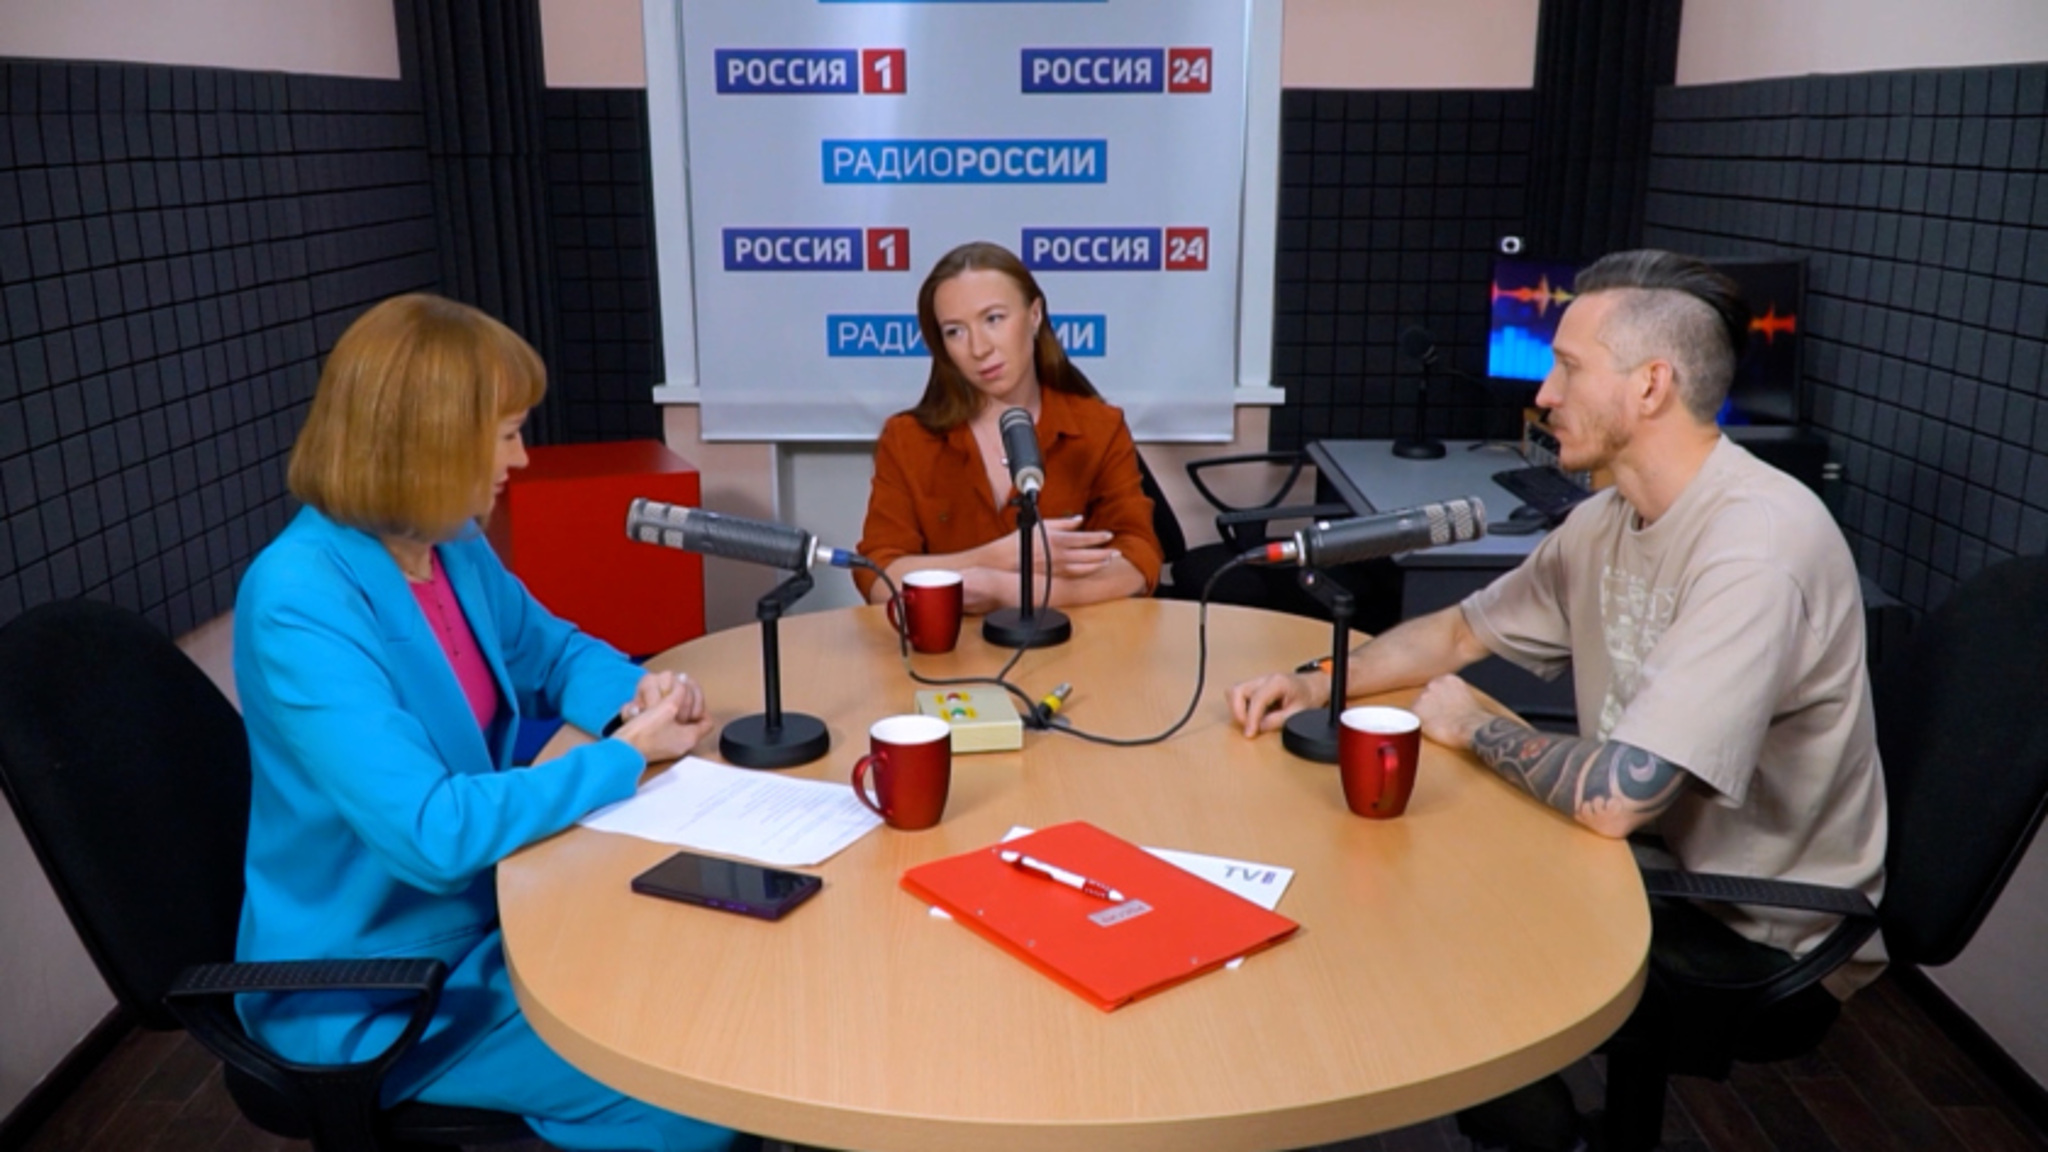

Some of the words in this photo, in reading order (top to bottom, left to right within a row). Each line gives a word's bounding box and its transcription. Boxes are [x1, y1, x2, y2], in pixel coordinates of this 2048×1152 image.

[727, 58, 847, 86] РОССИЯ
[873, 55, 893, 90] 1
[1032, 57, 1152, 85] РОССИЯ
[1172, 57, 1208, 84] 24
[735, 236, 852, 264] РОССИЯ
[877, 233, 896, 267] 1
[1033, 236, 1150, 263] РОССИЯ
[1169, 236, 1205, 262] 24
